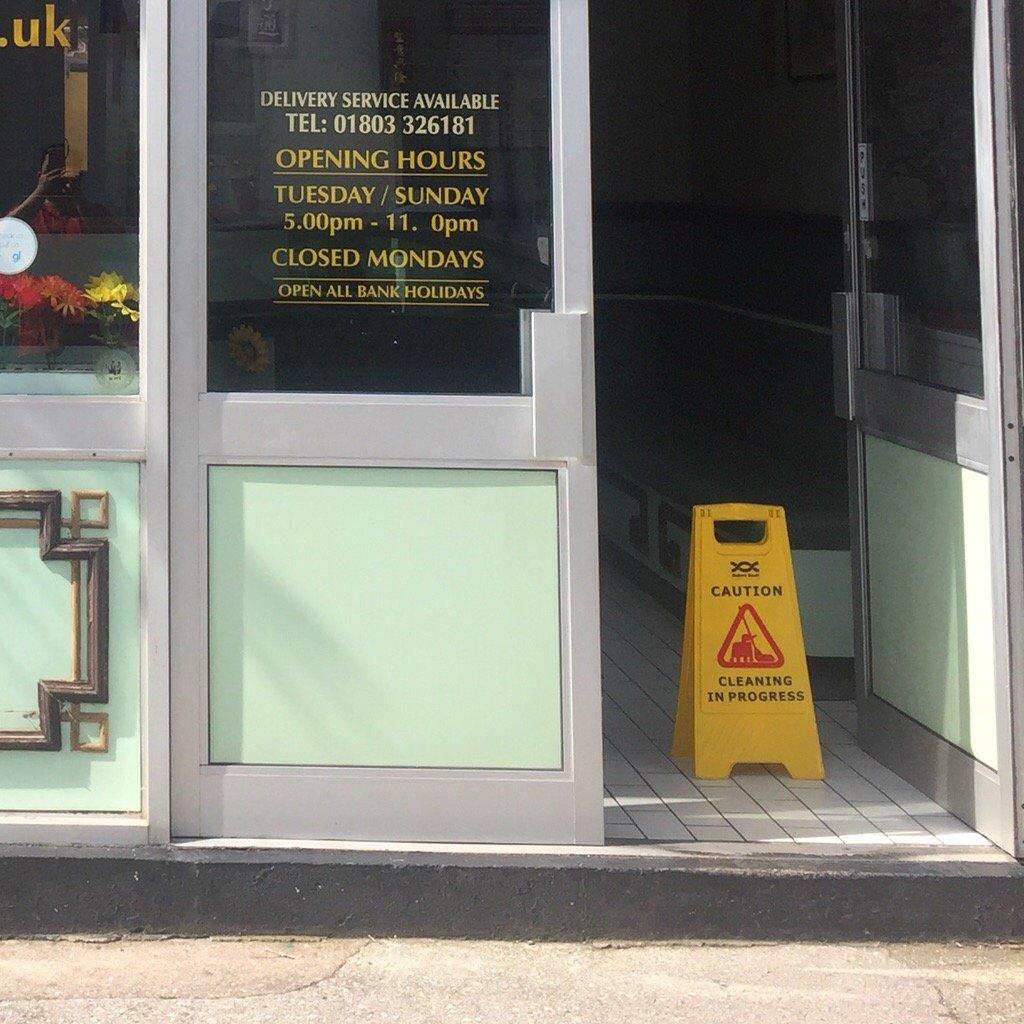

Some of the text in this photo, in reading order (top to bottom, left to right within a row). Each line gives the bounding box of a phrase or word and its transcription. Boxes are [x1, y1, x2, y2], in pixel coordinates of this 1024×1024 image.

[260, 91, 500, 110] DELIVERY SERVICE AVAILABLE
[285, 113, 474, 135] TEL: 01803 326181
[275, 148, 486, 171] OPENING HOURS
[274, 185, 376, 205] TUESDAY
[395, 186, 489, 206] SUNDAY
[283, 213, 363, 236] 5.00pm
[272, 248, 484, 269] CLOSED MONDAYS
[278, 284, 485, 300] OPEN ALL BANK HOLIDAYS
[710, 585, 783, 598] CAUTION
[718, 675, 793, 687] CLEANING
[707, 690, 805, 702] IN PROGRESS
